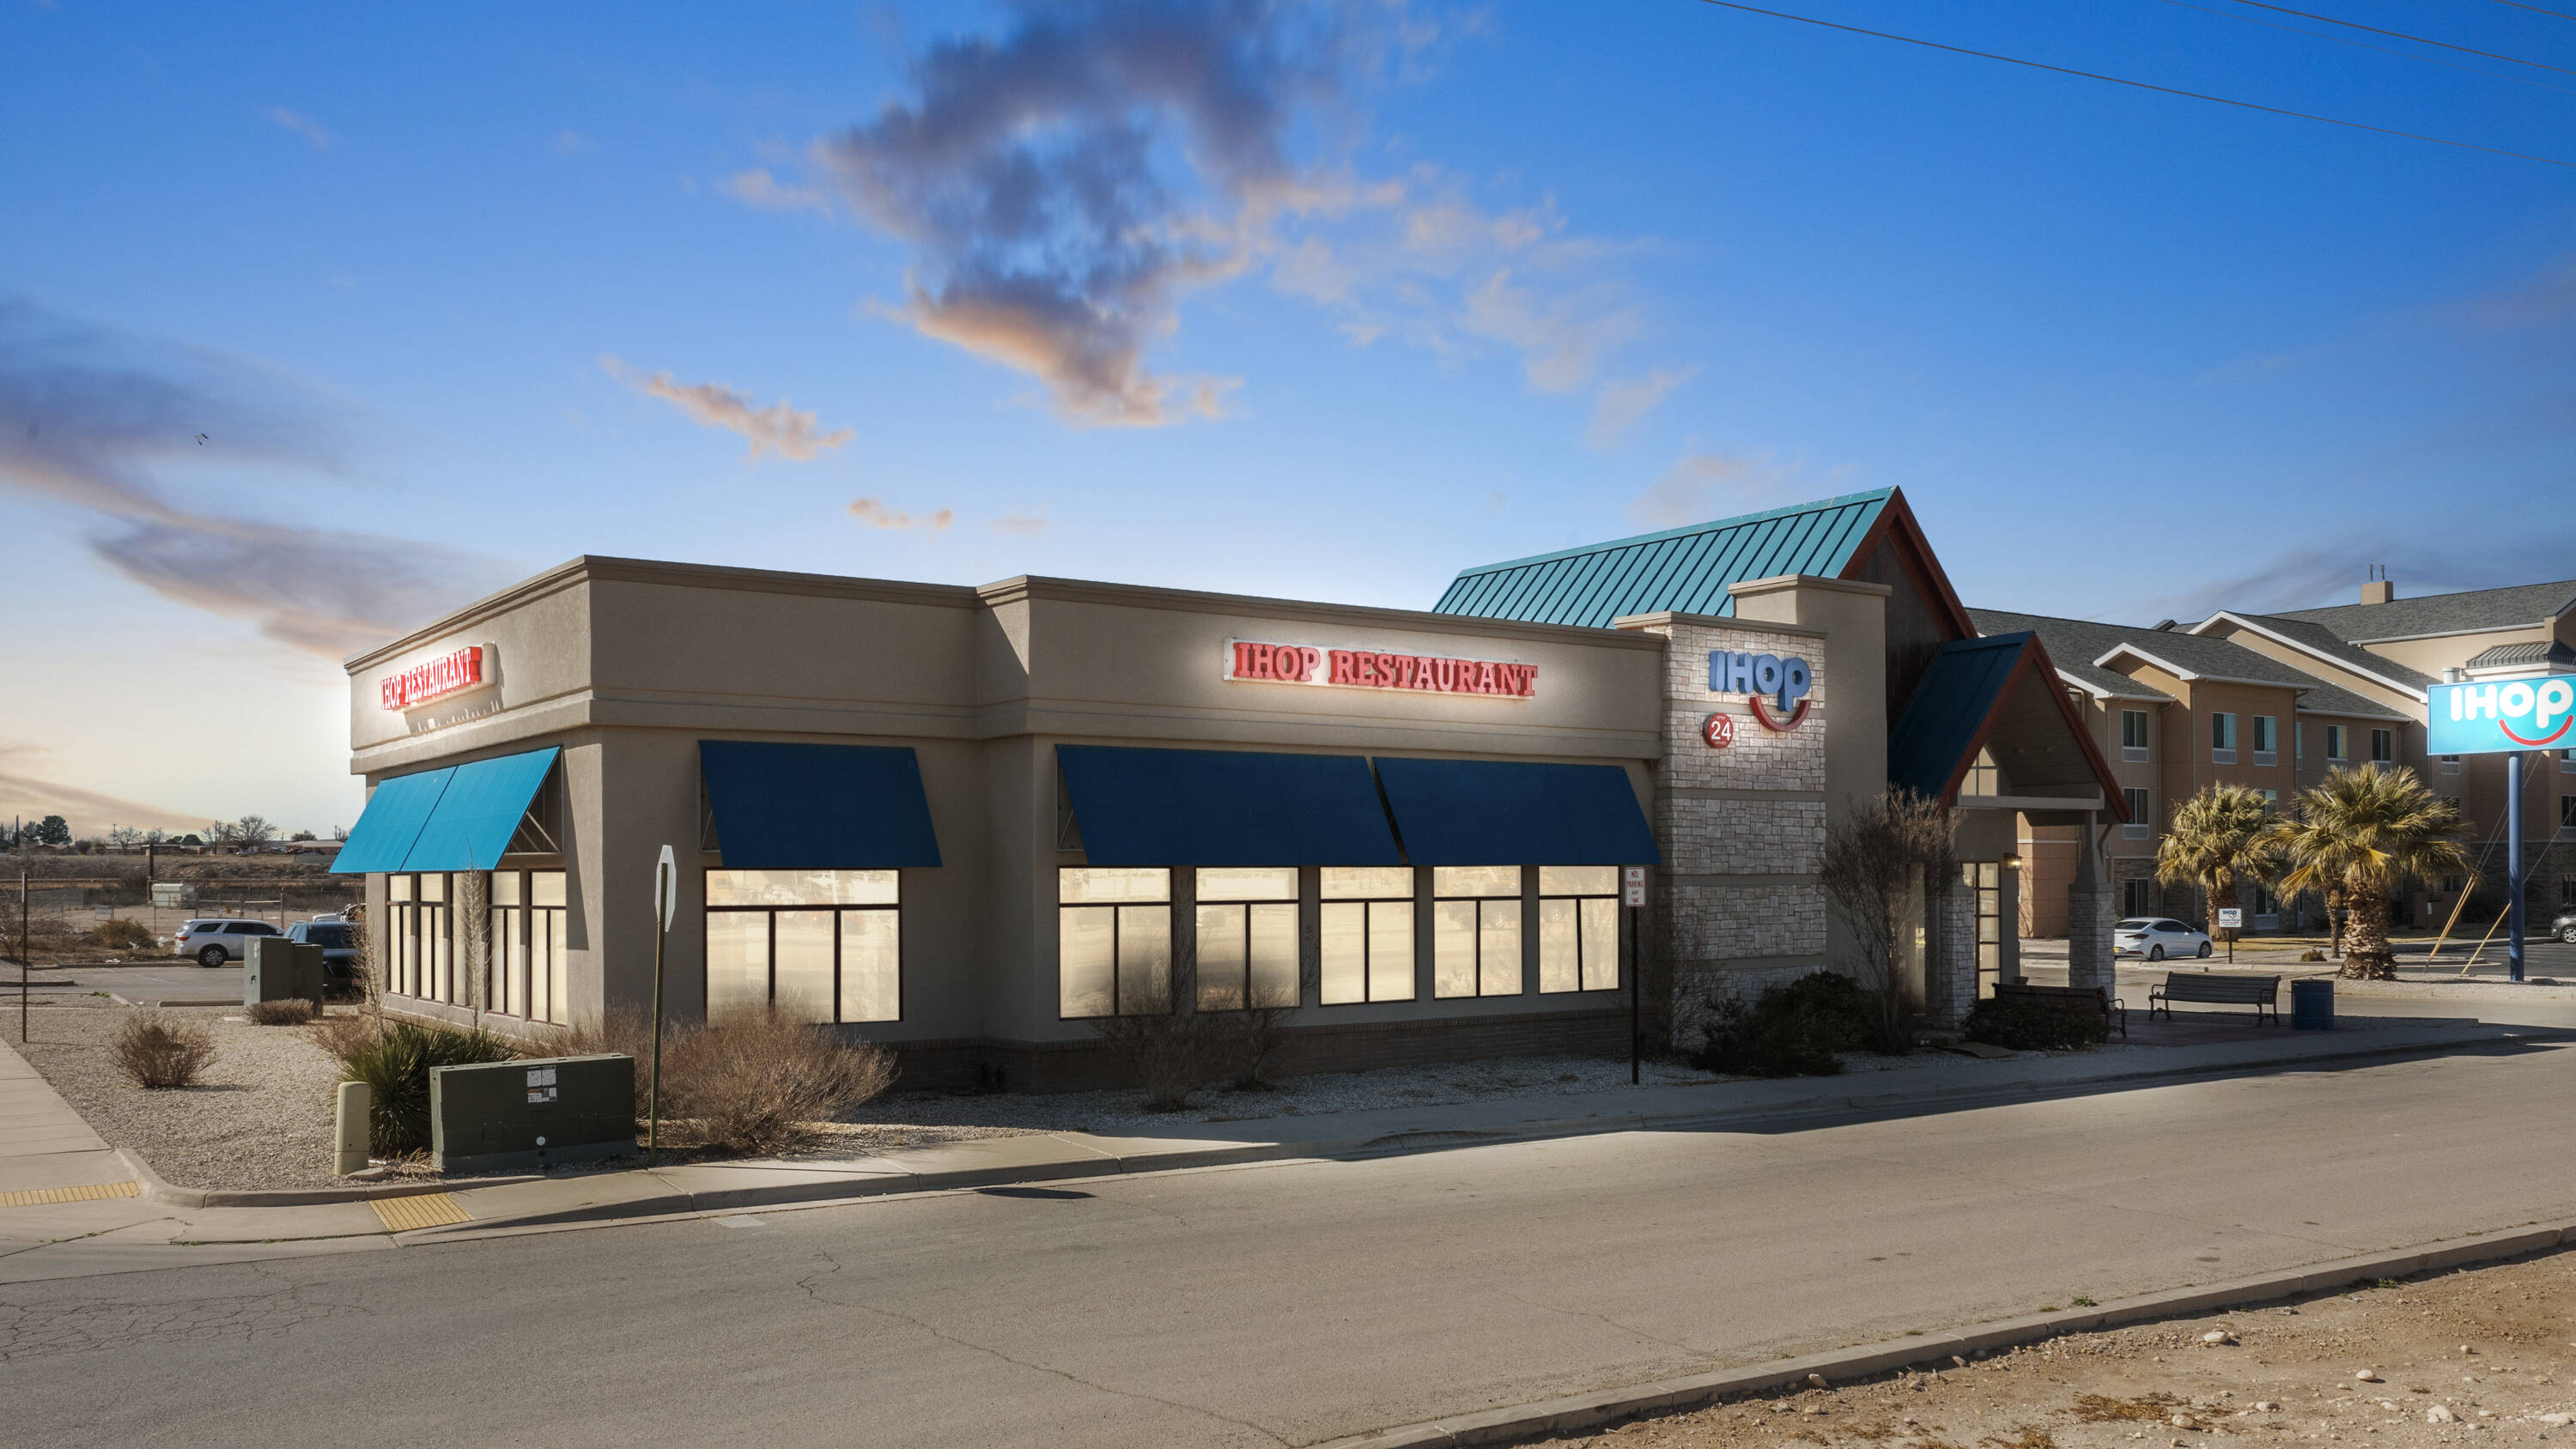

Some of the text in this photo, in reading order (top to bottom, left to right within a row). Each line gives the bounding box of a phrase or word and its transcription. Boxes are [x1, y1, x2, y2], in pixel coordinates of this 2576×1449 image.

[380, 646, 478, 710] IHOP RESTAURANT
[1233, 642, 1538, 696] IHOP RESTAURANT
[1710, 720, 1732, 742] 24
